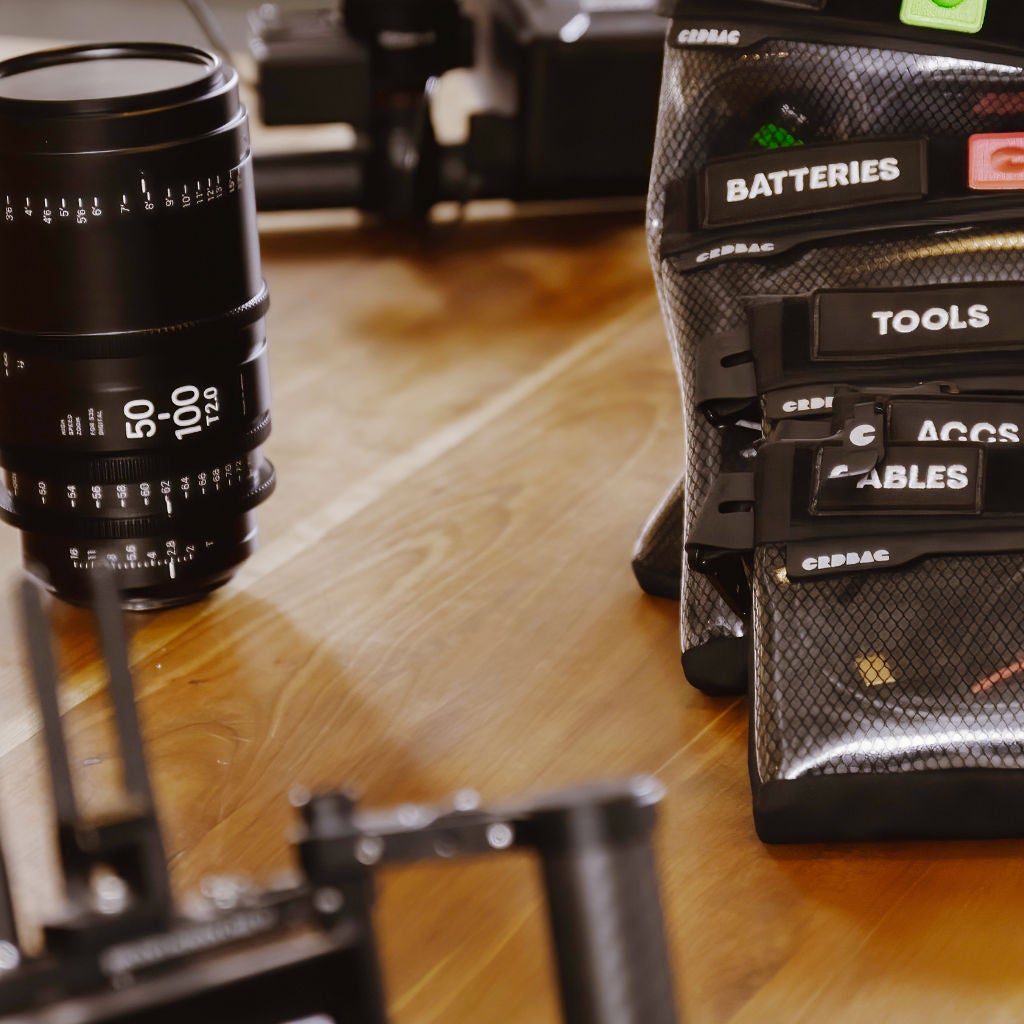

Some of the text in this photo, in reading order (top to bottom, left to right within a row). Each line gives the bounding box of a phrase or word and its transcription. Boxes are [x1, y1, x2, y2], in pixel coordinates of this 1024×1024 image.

[726, 157, 900, 203] BATTERIES
[872, 304, 990, 336] TOOLS
[123, 399, 157, 439] 50
[171, 385, 202, 440] 100
[203, 386, 219, 427] T2.0
[917, 419, 1020, 443] ACCS
